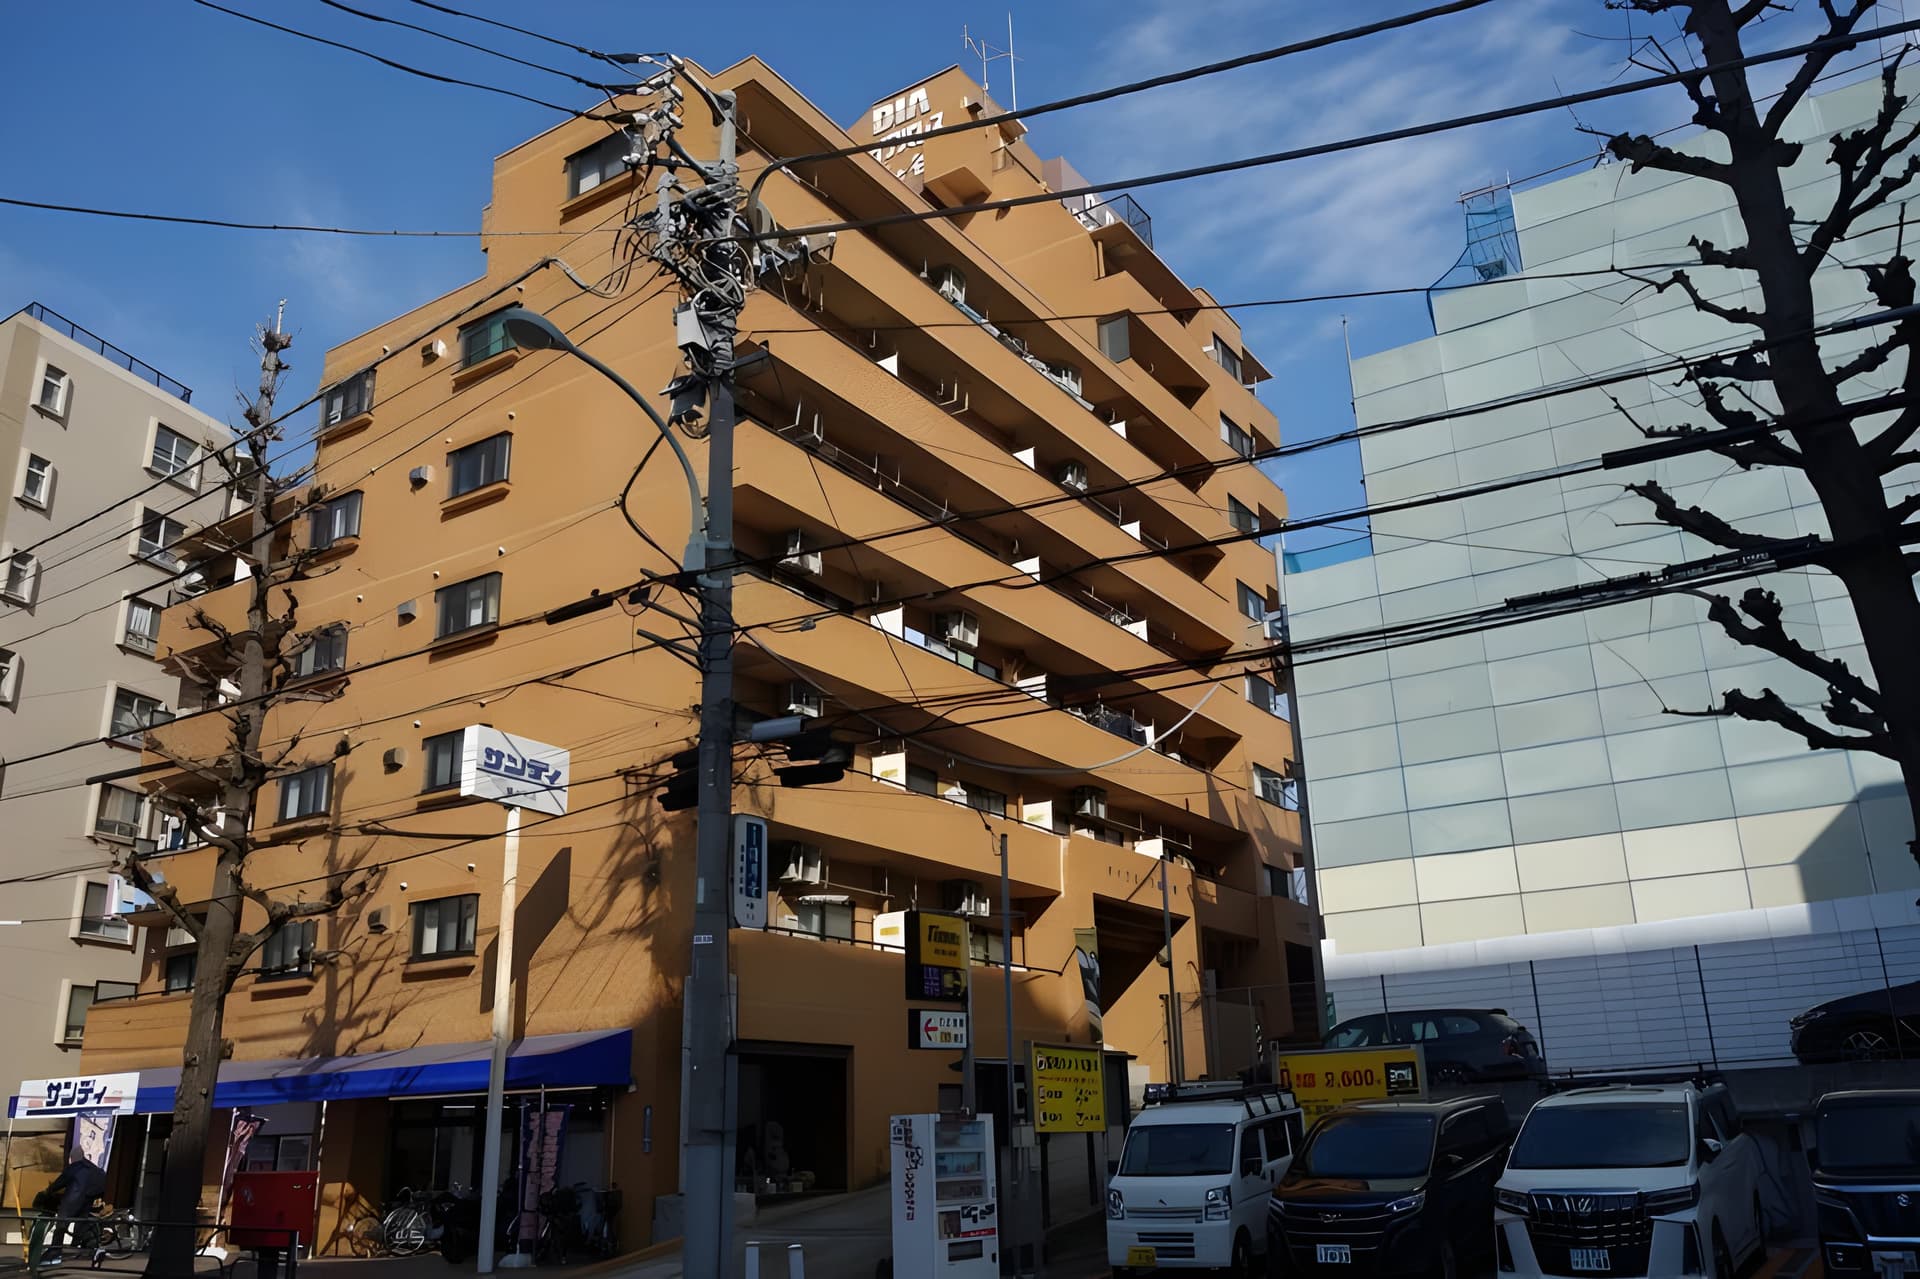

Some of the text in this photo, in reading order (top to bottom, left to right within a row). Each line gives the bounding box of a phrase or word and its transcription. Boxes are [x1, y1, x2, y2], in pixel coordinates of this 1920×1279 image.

[872, 87, 931, 136] DIA
[45, 1079, 107, 1107] サンディ
